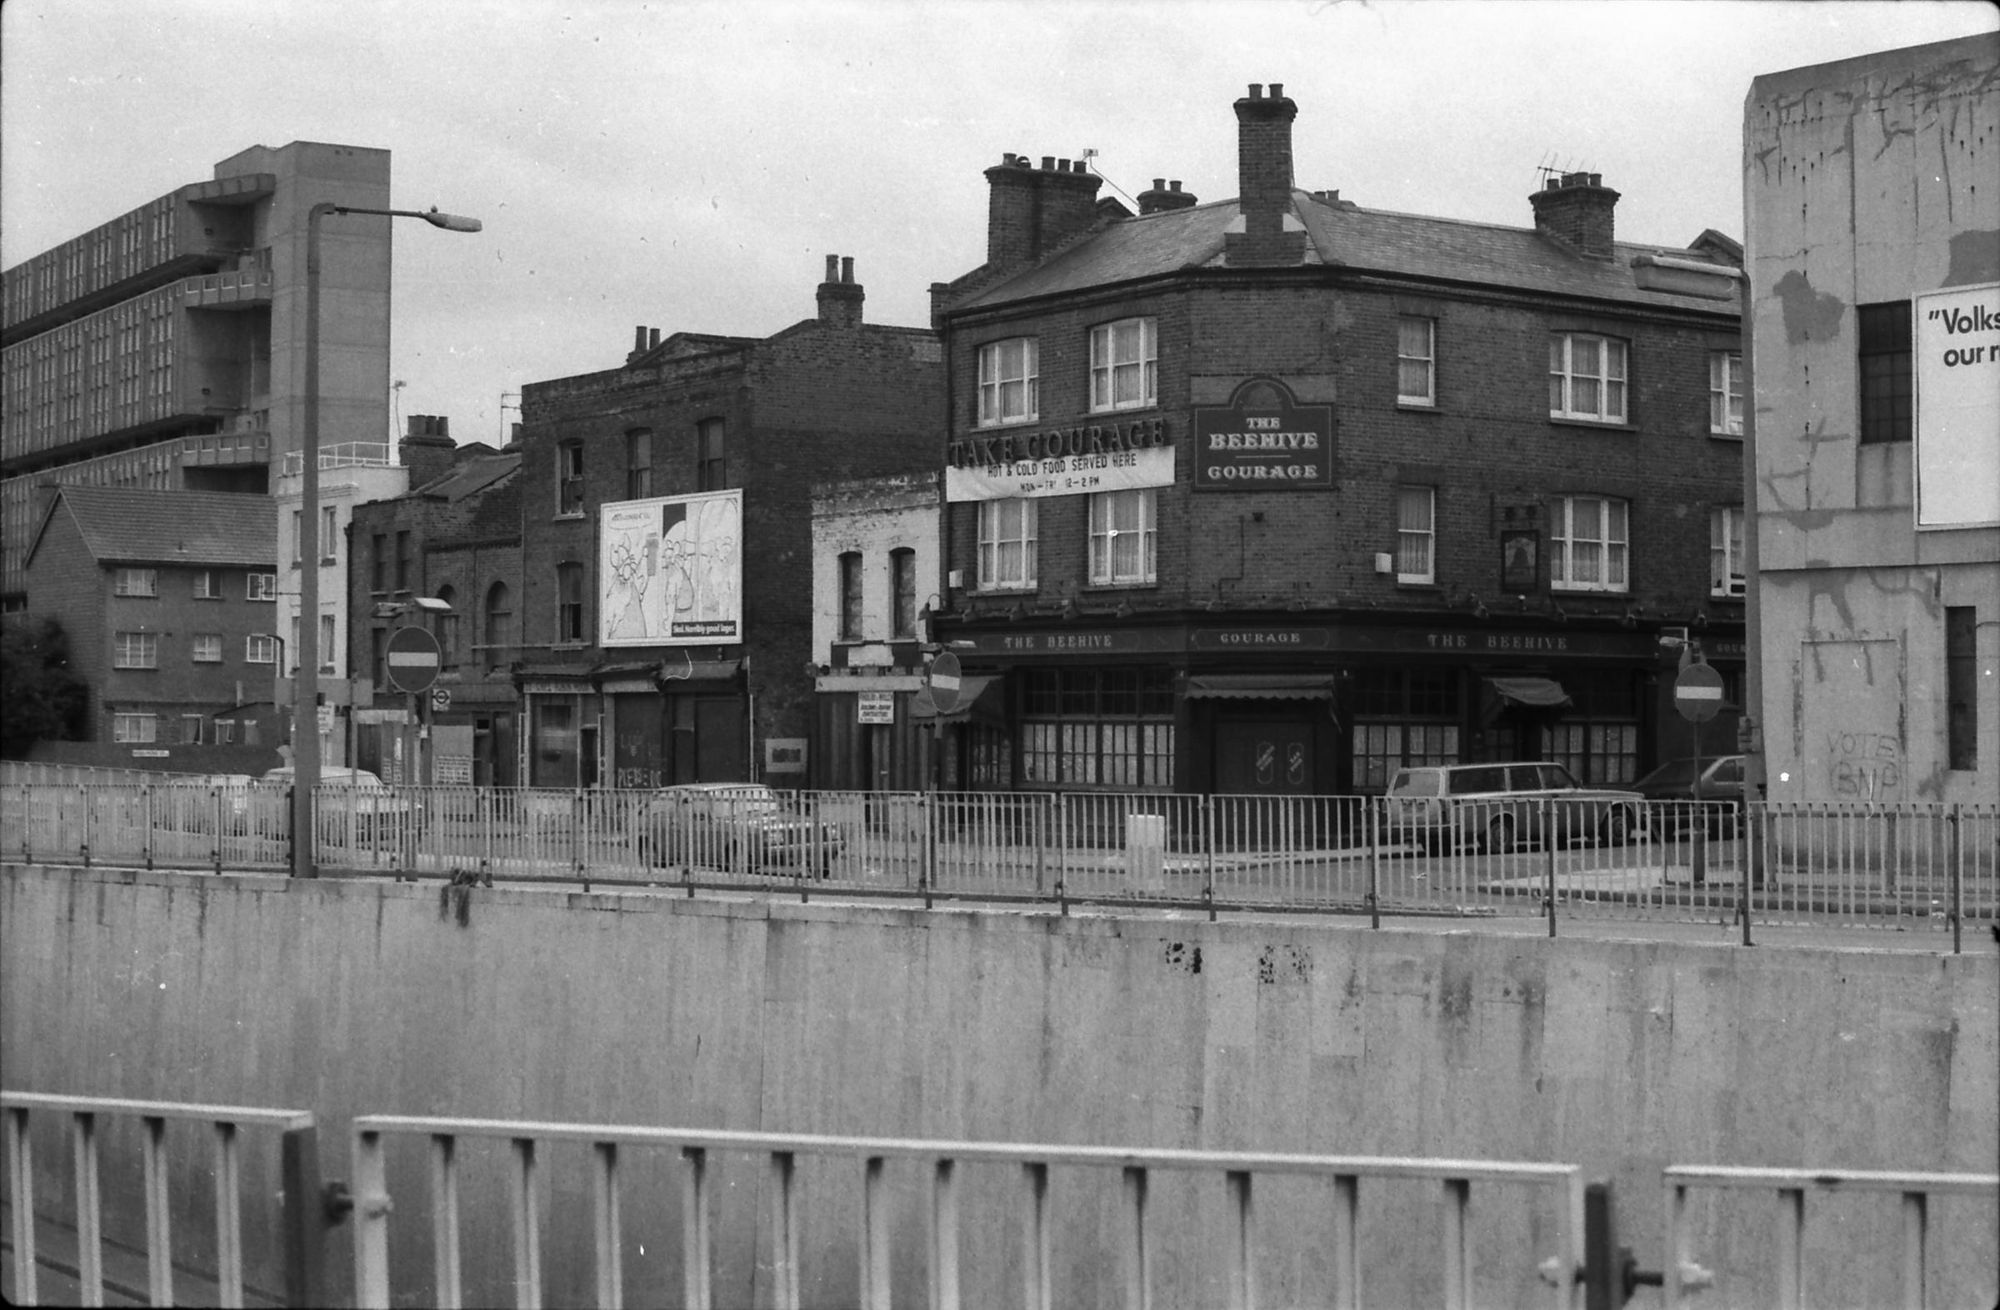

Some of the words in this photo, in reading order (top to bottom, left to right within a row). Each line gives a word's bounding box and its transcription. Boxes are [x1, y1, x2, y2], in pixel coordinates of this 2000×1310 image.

[1943, 346, 1985, 368] our
[1246, 416, 1281, 430] THE
[950, 435, 1014, 469] TAKE
[1027, 417, 1167, 461] COURAGE
[1208, 432, 1320, 450] BEEHIVE
[1016, 462, 1038, 477] COLD
[1043, 459, 1066, 475] FOOD
[1071, 455, 1108, 472] SERVED
[1113, 453, 1137, 468] HERE
[1207, 464, 1320, 480] COURAGE
[1004, 636, 1034, 649] THE
[1047, 634, 1113, 649] BEEHIVE
[1220, 632, 1301, 644] COURAGE
[1427, 633, 1467, 648] THE
[1488, 634, 1568, 650] BEEHIVE
